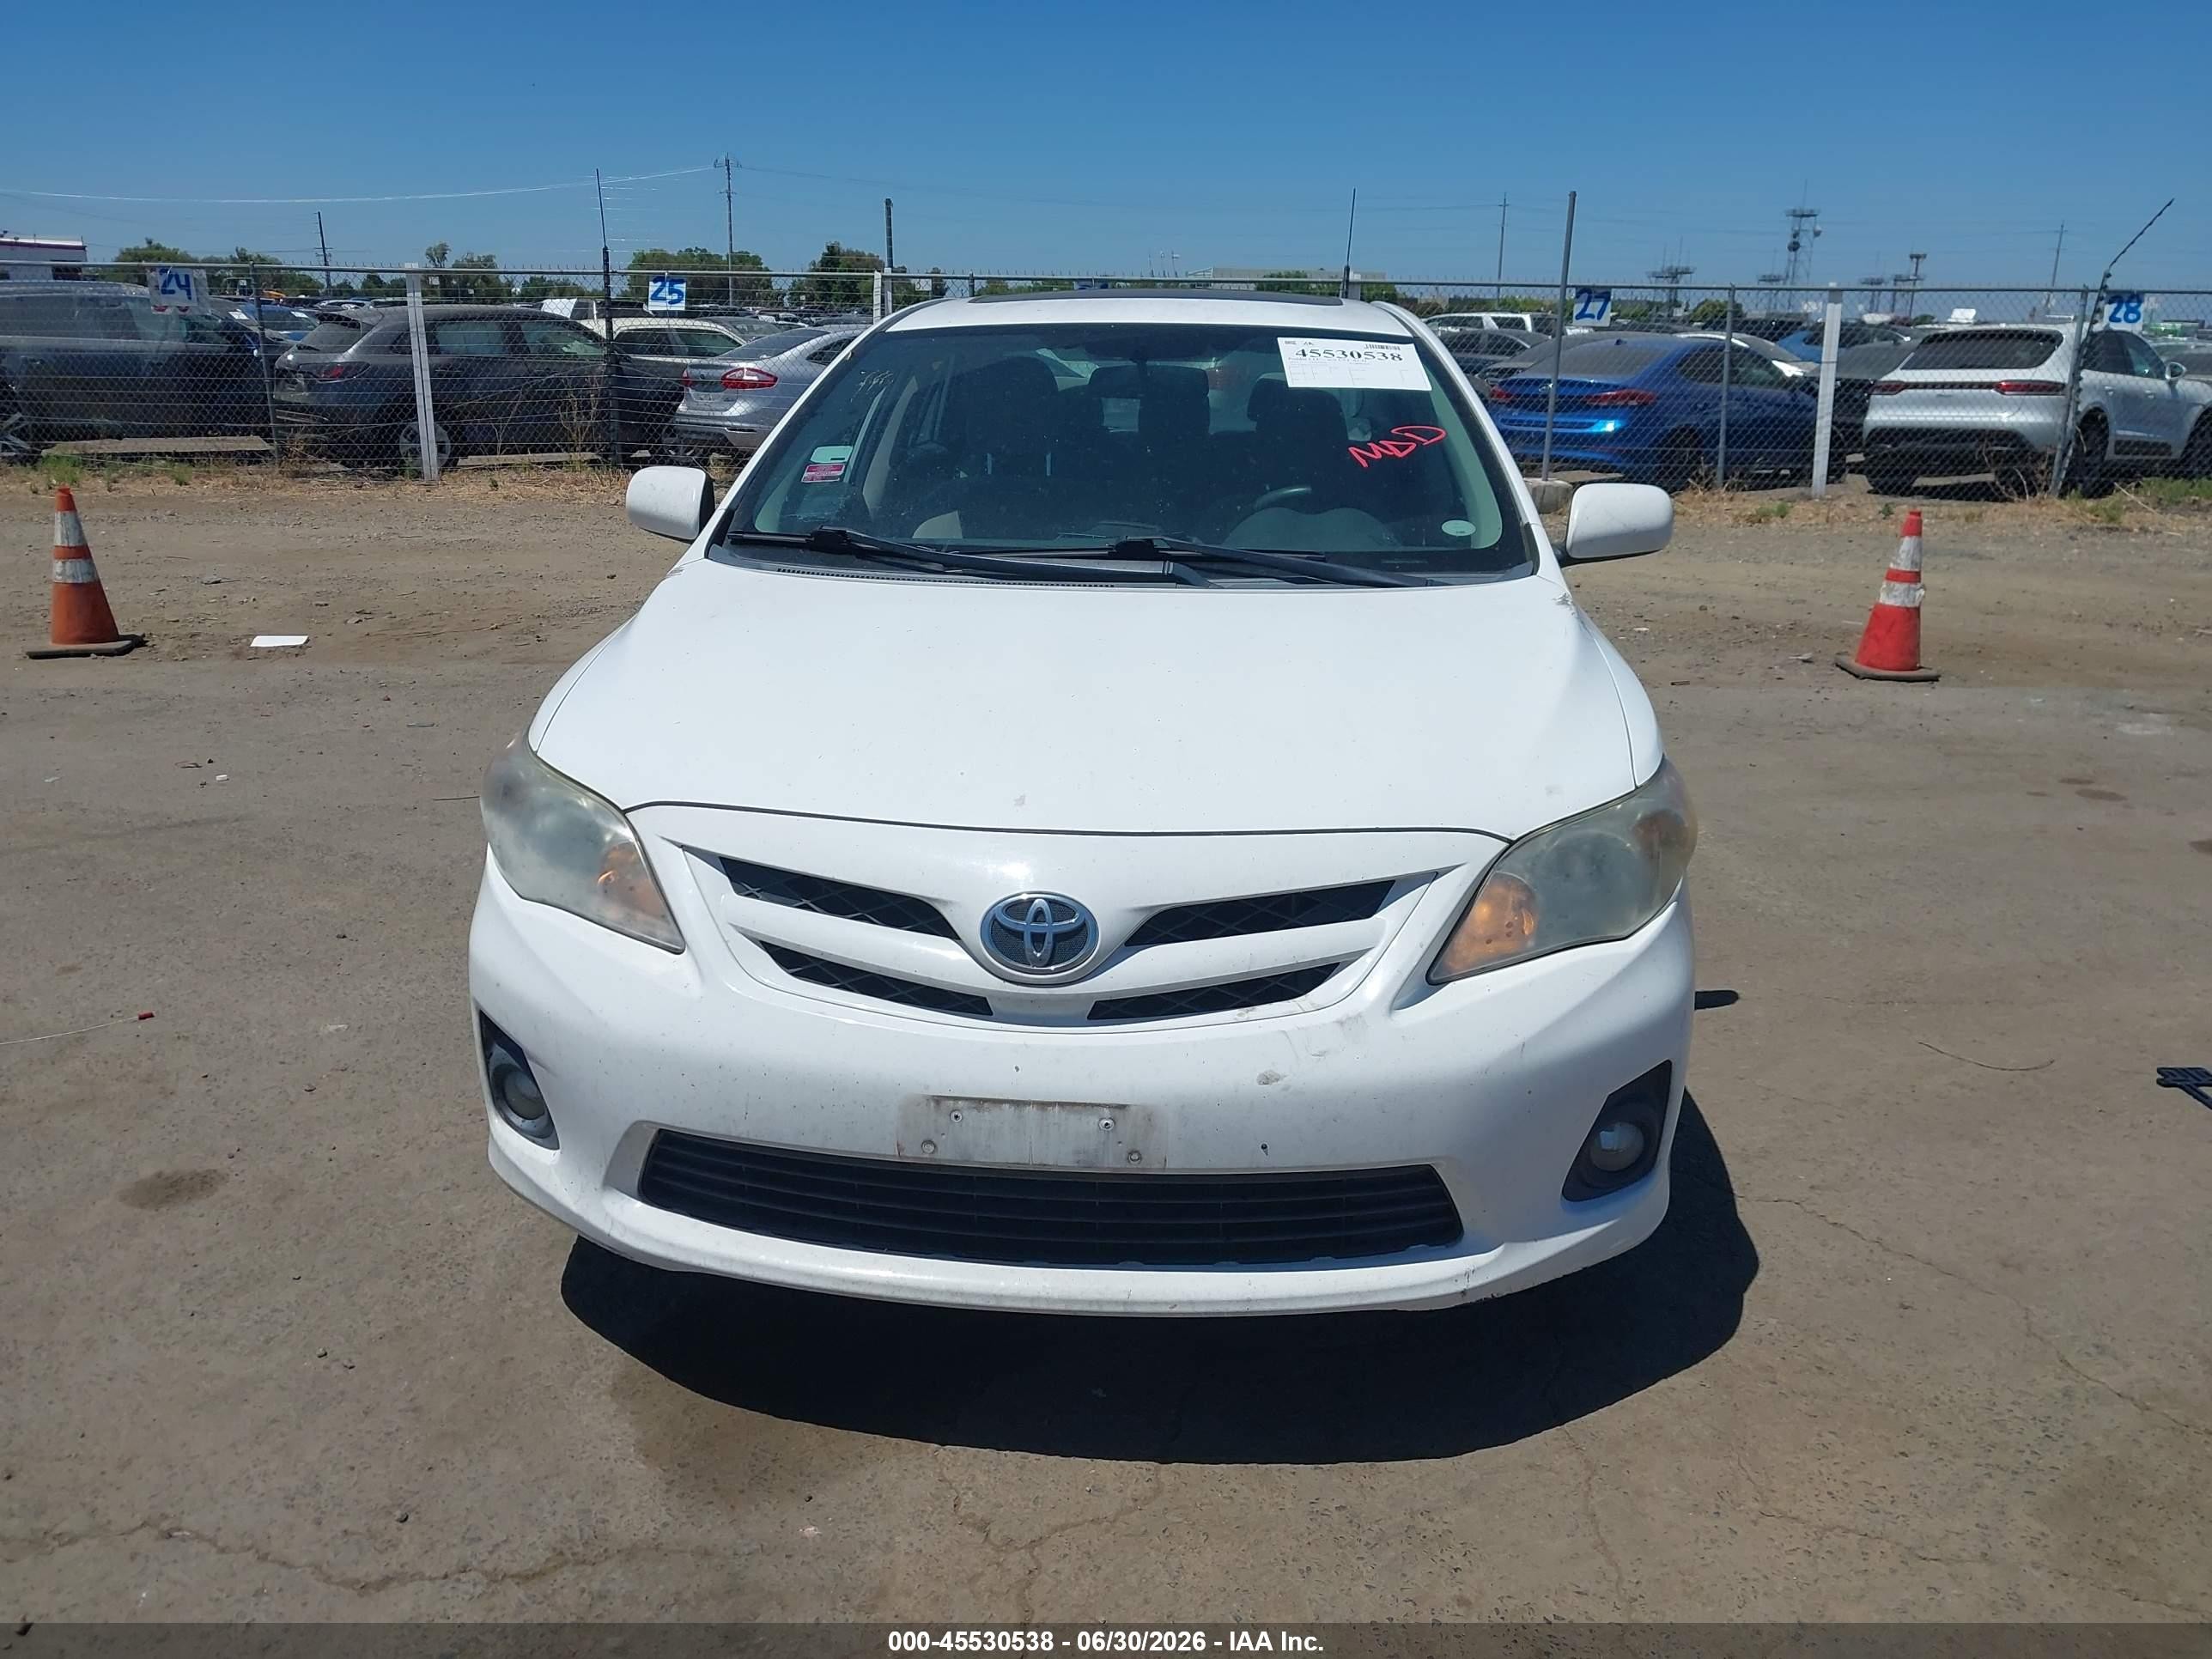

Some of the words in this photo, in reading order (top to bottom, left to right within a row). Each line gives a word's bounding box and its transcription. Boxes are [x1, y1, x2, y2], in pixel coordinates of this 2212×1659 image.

[159, 268, 191, 300] 24
[651, 275, 684, 305] 25
[1576, 288, 1612, 320] 27
[2108, 294, 2142, 324] 28
[1295, 348, 1403, 362] 45530538
